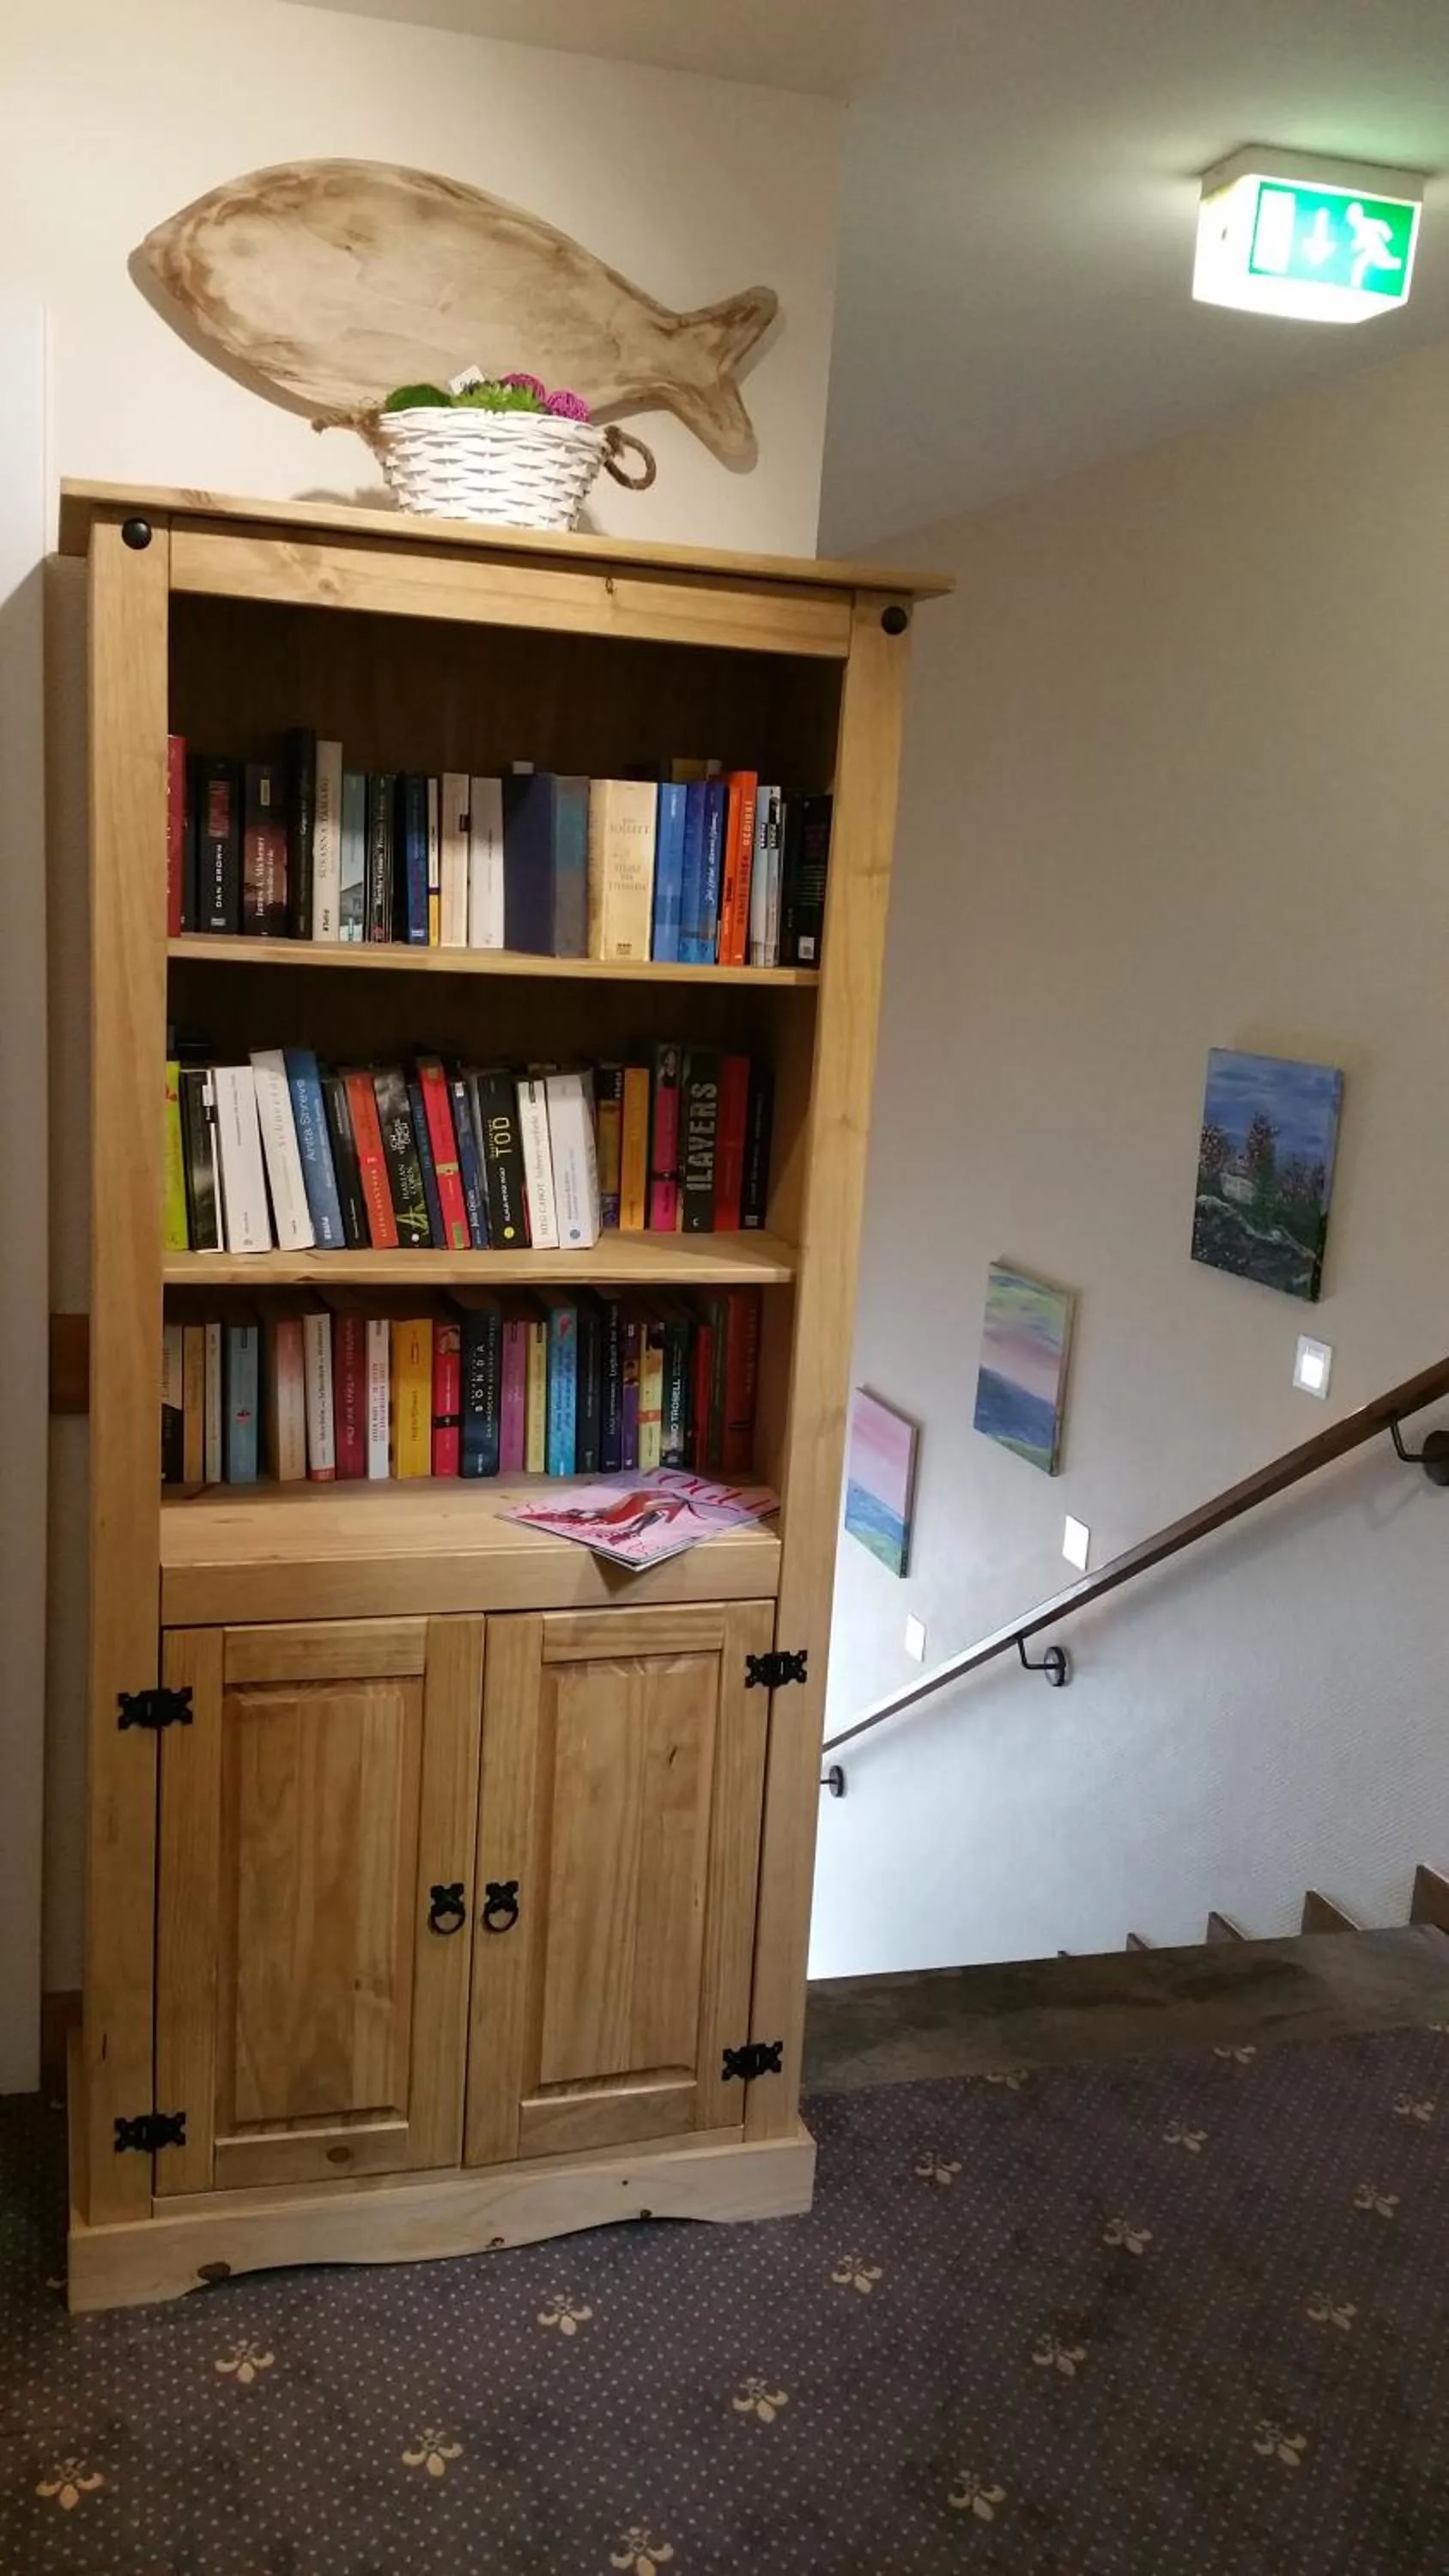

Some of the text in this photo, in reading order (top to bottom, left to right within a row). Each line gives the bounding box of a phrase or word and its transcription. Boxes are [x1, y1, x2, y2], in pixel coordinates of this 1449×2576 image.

[215, 885, 223, 908] DAN
[302, 1127, 317, 1162] Anita
[493, 1115, 512, 1158] TOD
